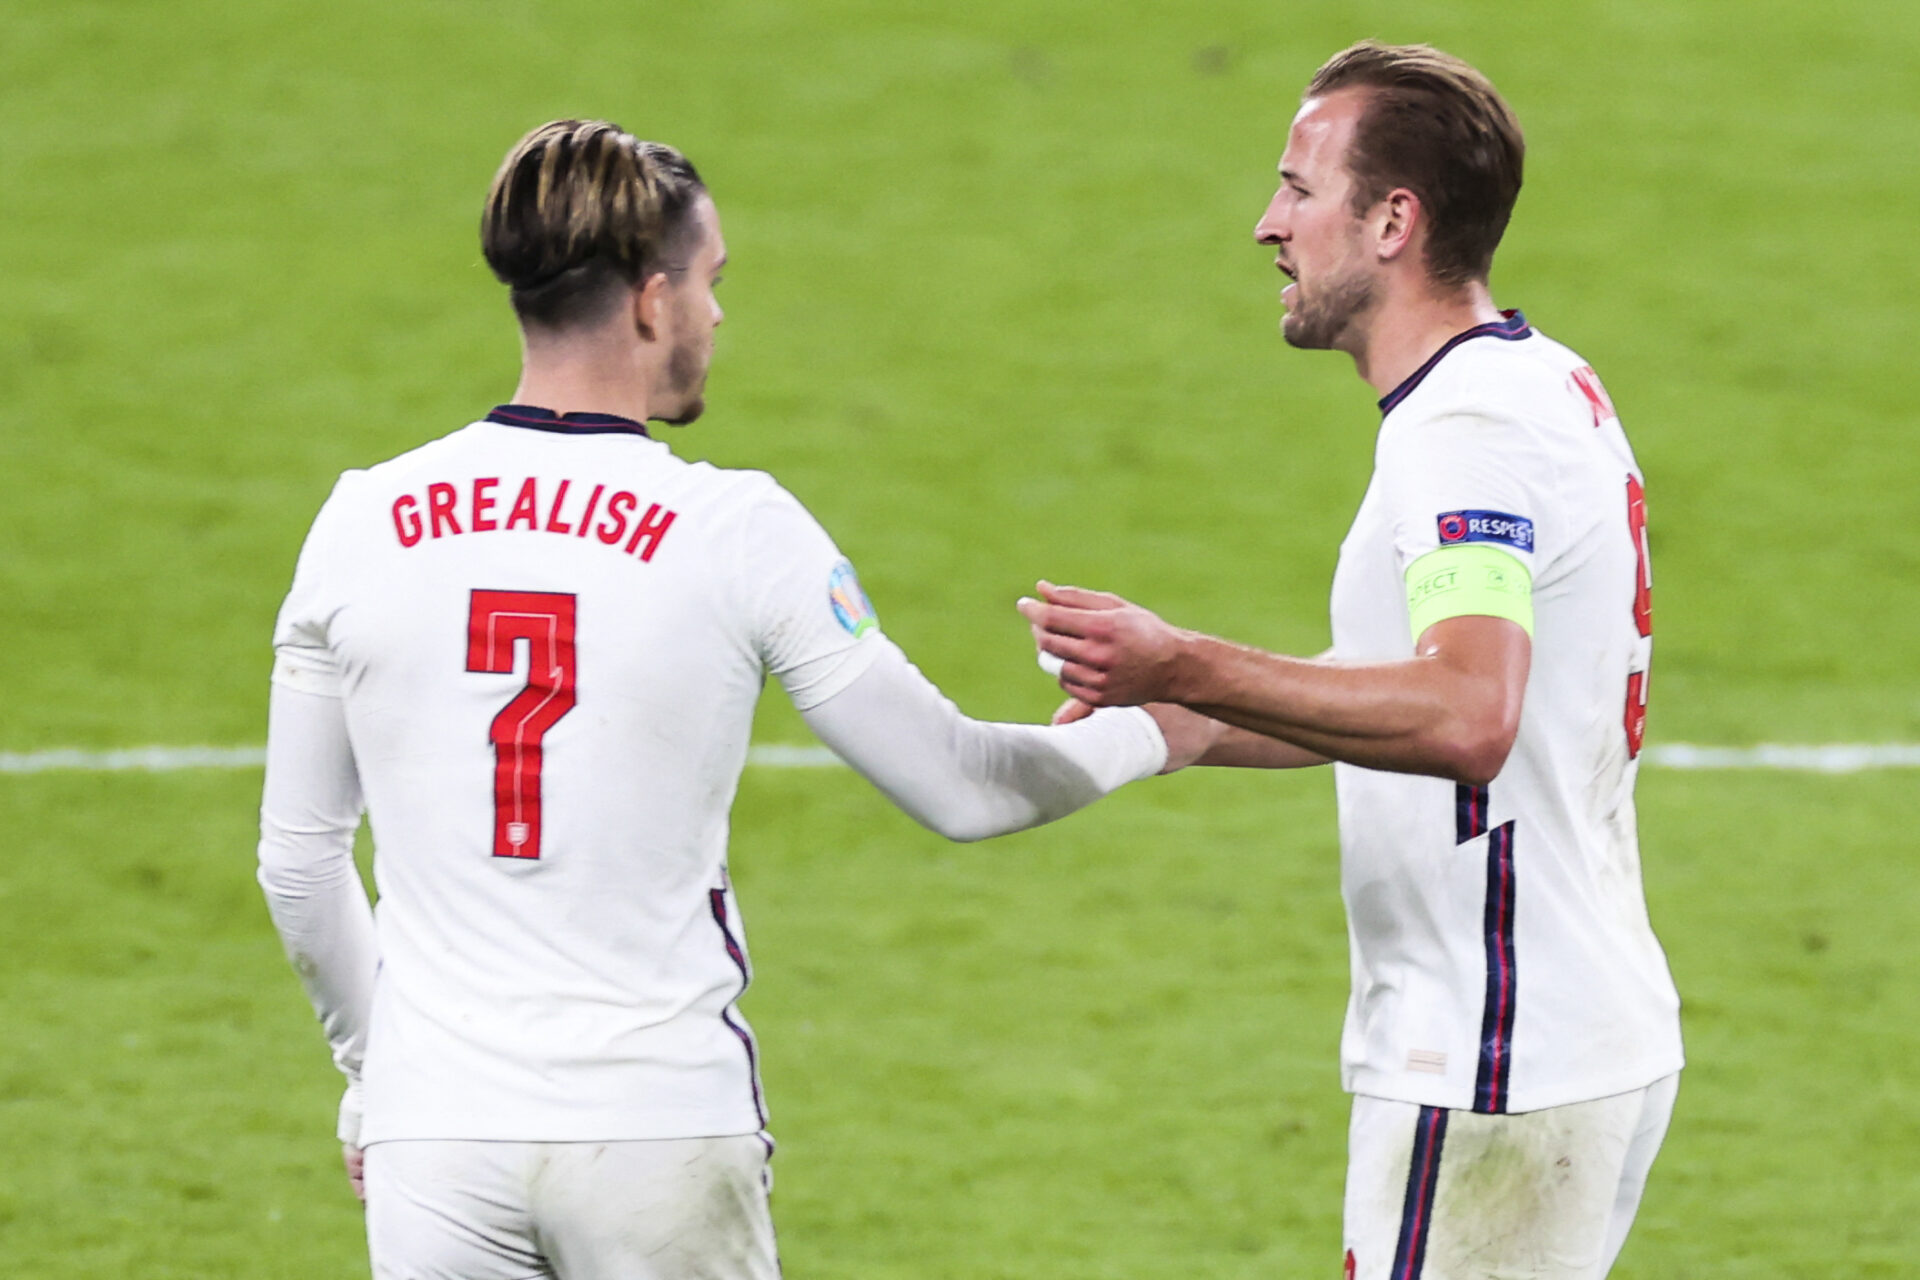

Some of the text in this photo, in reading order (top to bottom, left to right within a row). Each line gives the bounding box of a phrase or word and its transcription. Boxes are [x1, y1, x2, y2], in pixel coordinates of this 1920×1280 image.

[391, 476, 678, 563] GREALISH
[1468, 518, 1534, 544] RESPECT
[465, 588, 578, 860] 7
